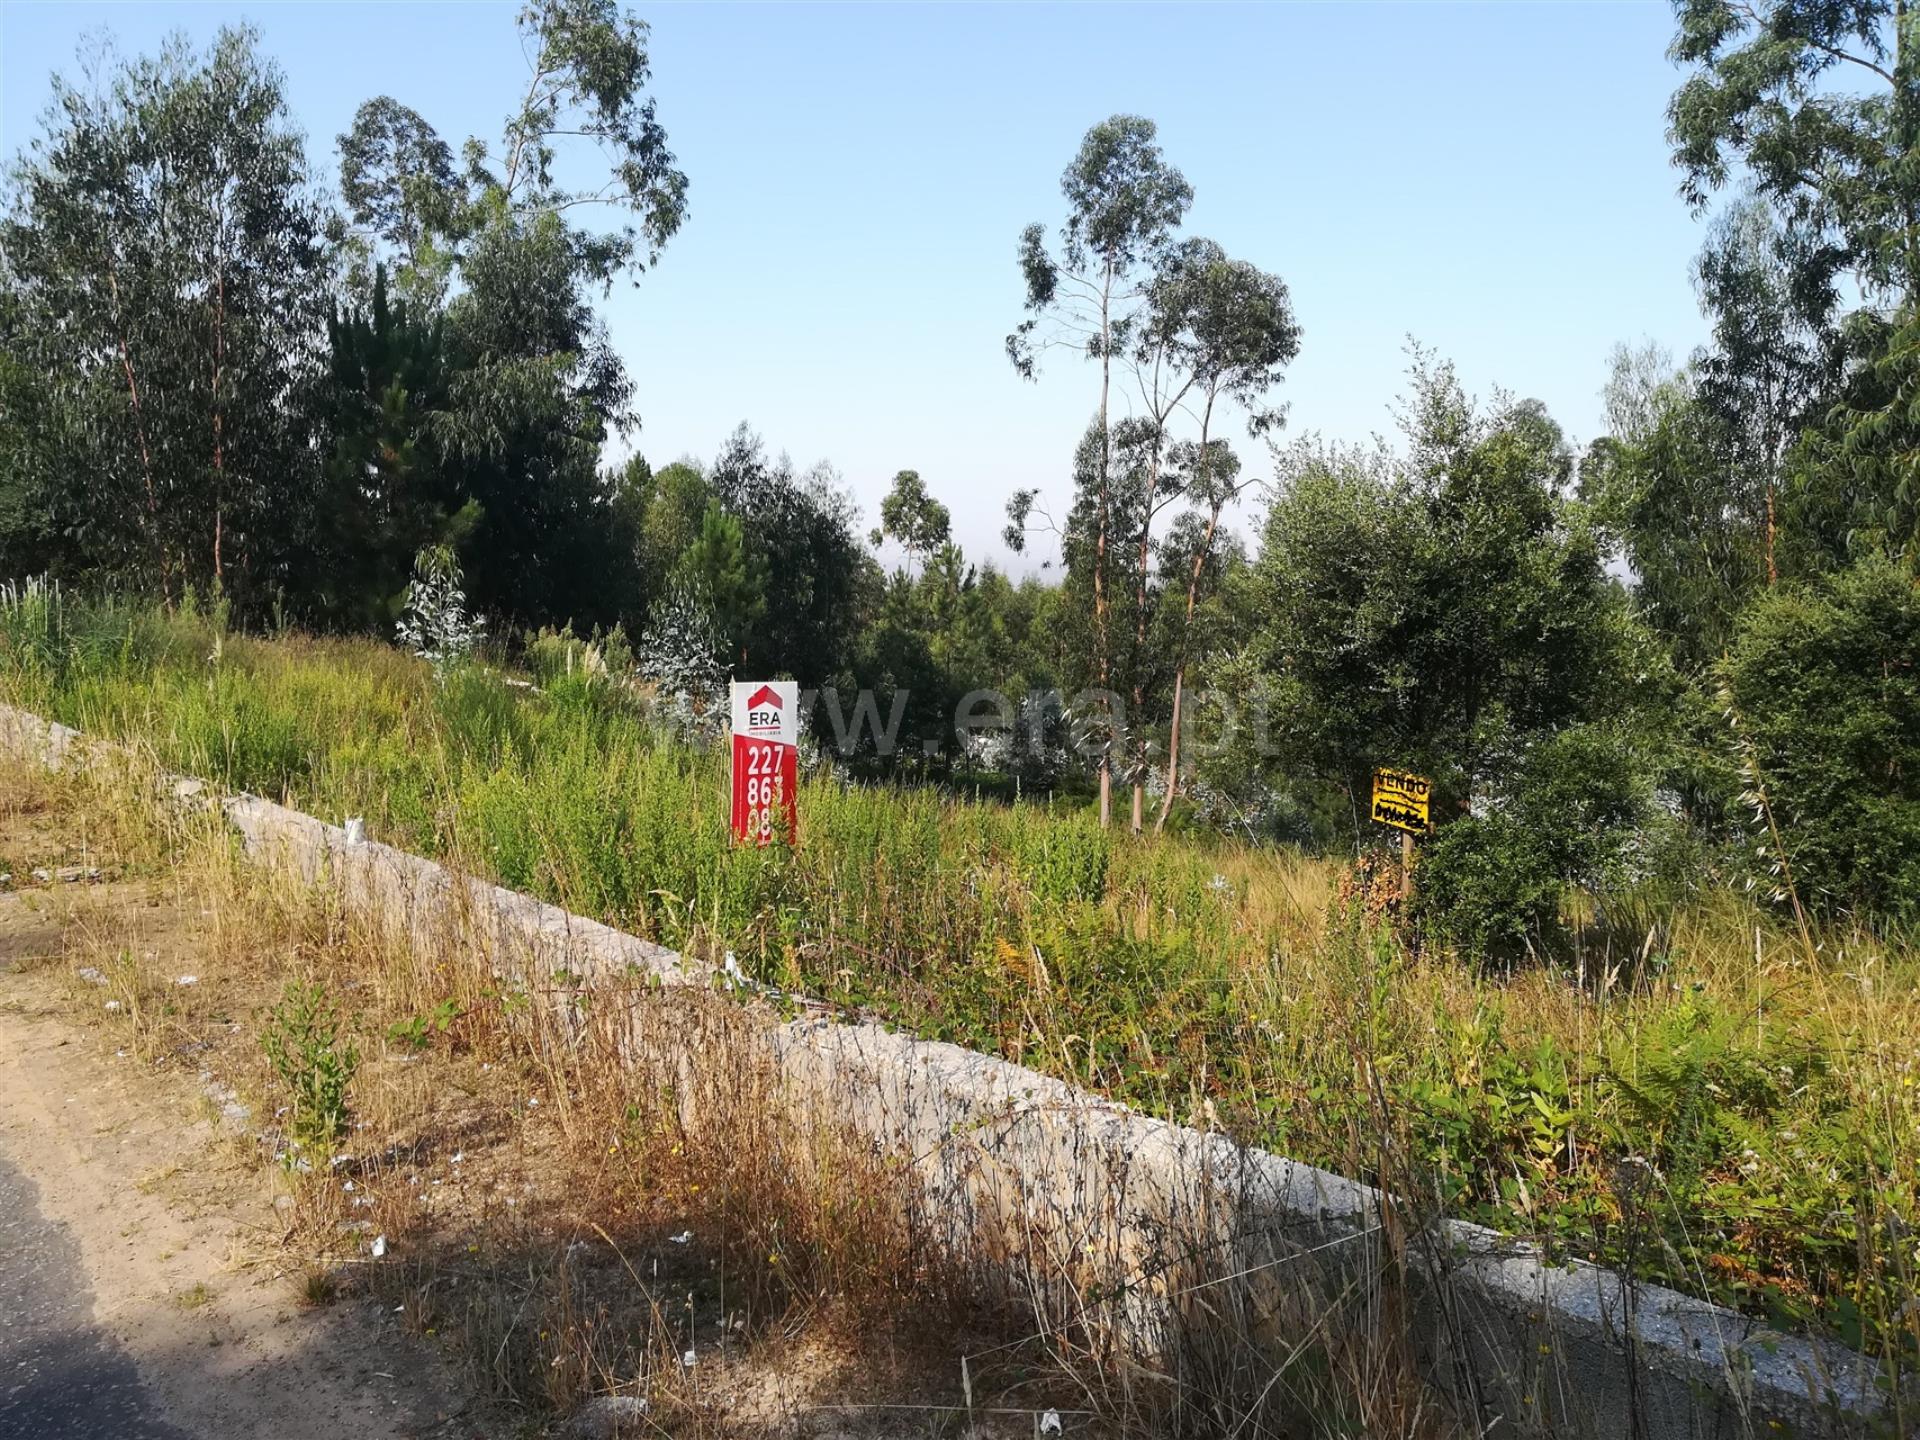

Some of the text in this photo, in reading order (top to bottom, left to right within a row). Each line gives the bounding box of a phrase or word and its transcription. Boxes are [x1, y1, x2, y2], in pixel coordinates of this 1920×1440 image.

[749, 712, 781, 726] ERA
[748, 745, 784, 775] 227
[1377, 773, 1428, 795] VENDO
